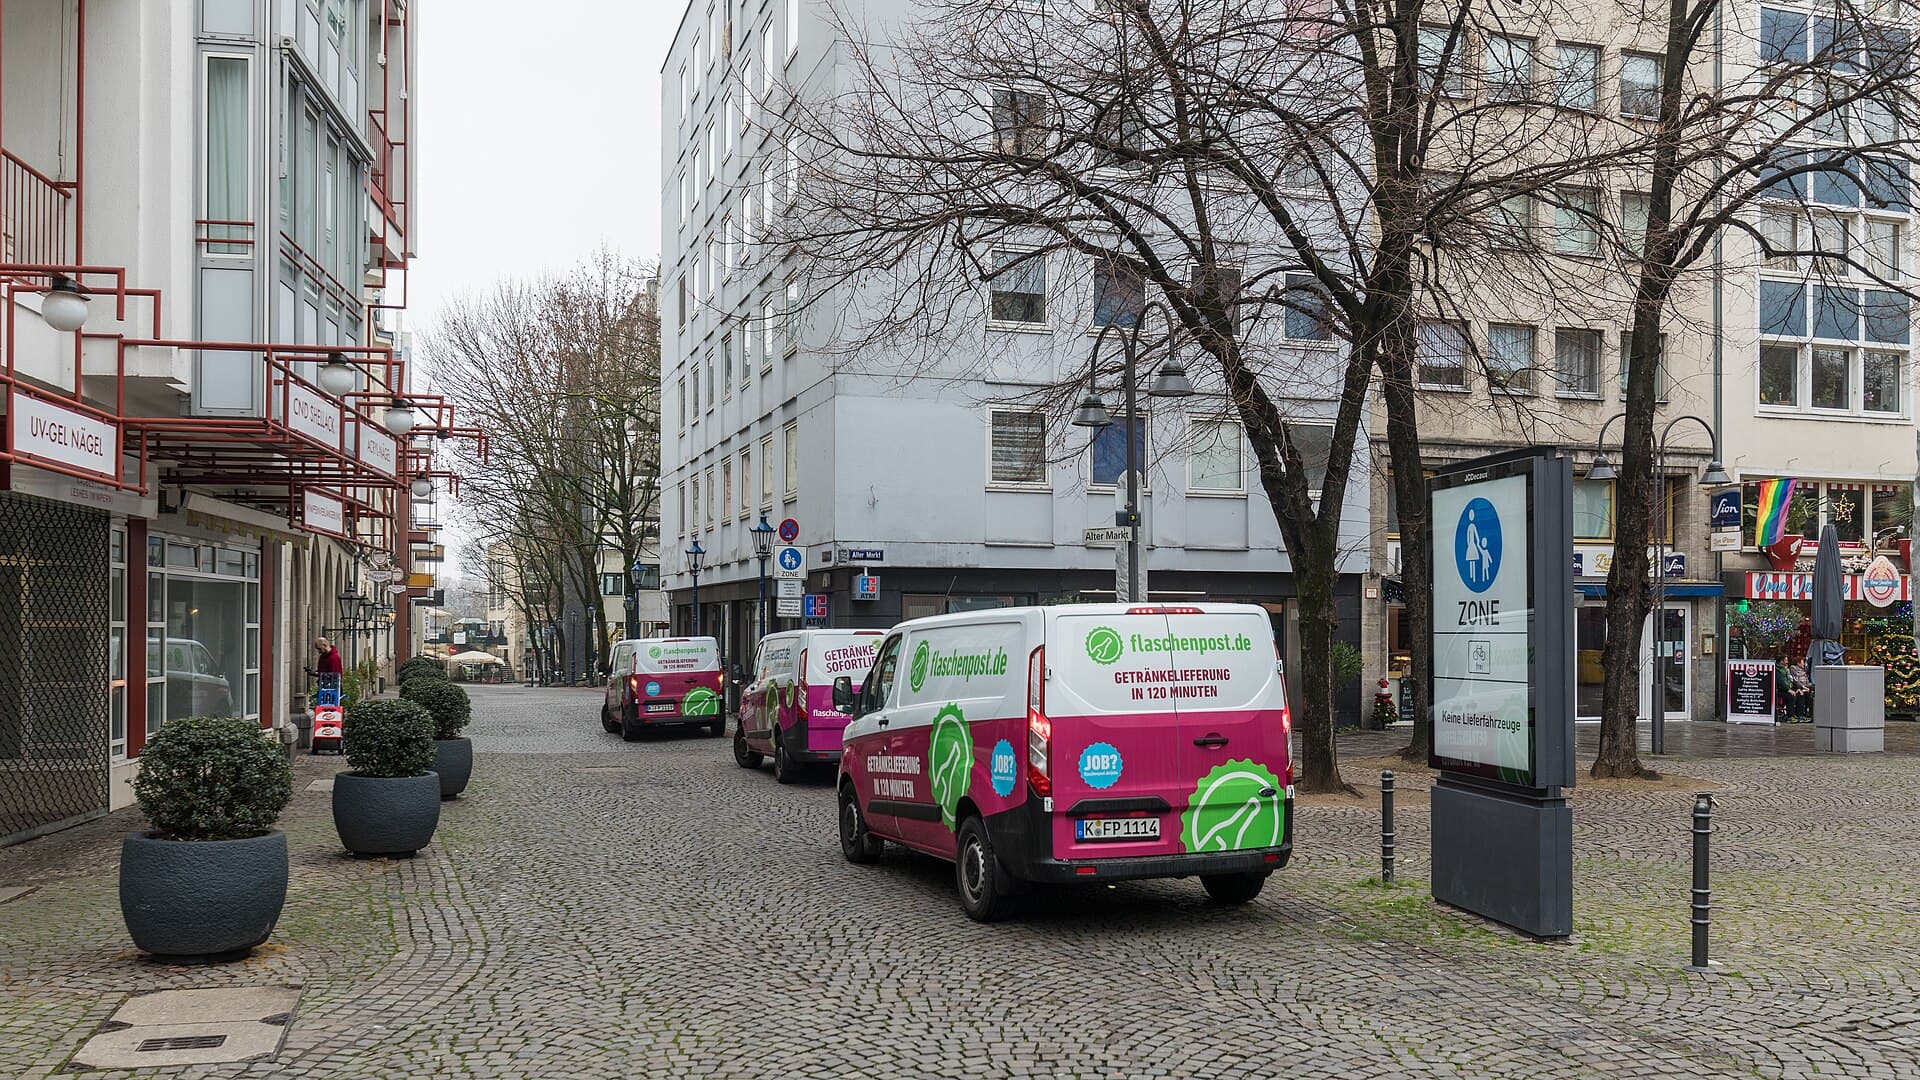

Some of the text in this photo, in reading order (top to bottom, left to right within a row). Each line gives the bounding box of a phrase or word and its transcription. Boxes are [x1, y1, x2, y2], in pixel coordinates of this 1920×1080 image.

[293, 397, 335, 434] CND SHELLACK
[30, 416, 103, 457] UV-GEL NÄGEL
[1464, 472, 1488, 482] JCDecaux
[1711, 498, 1739, 519] Sion
[1085, 531, 1129, 541] Alter Markt
[851, 551, 865, 559] Alter
[866, 551, 881, 559] Markt
[1755, 573, 1790, 593] Oma
[806, 618, 827, 626] ATM
[1458, 600, 1500, 626] ZONE
[824, 644, 875, 661] GETRÄNKE
[1130, 633, 1251, 655] flaschenpost.de
[930, 646, 1008, 683] flaschenpost.de
[1114, 667, 1231, 684] GETRÄNKELIEFERUNG
[1131, 685, 1218, 700] IN 120 MINUTEN
[1441, 710, 1521, 734] Keine Lieferfahrzeuge
[867, 753, 921, 775] GETRÄNKELIEFERUNG
[994, 754, 1014, 774] JOB?
[1084, 753, 1118, 771] JOB?
[873, 778, 915, 799] IN 120 MINUTEN
[1085, 822, 1094, 836] K
[1103, 821, 1121, 836] FP
[1123, 820, 1158, 835] 1114
